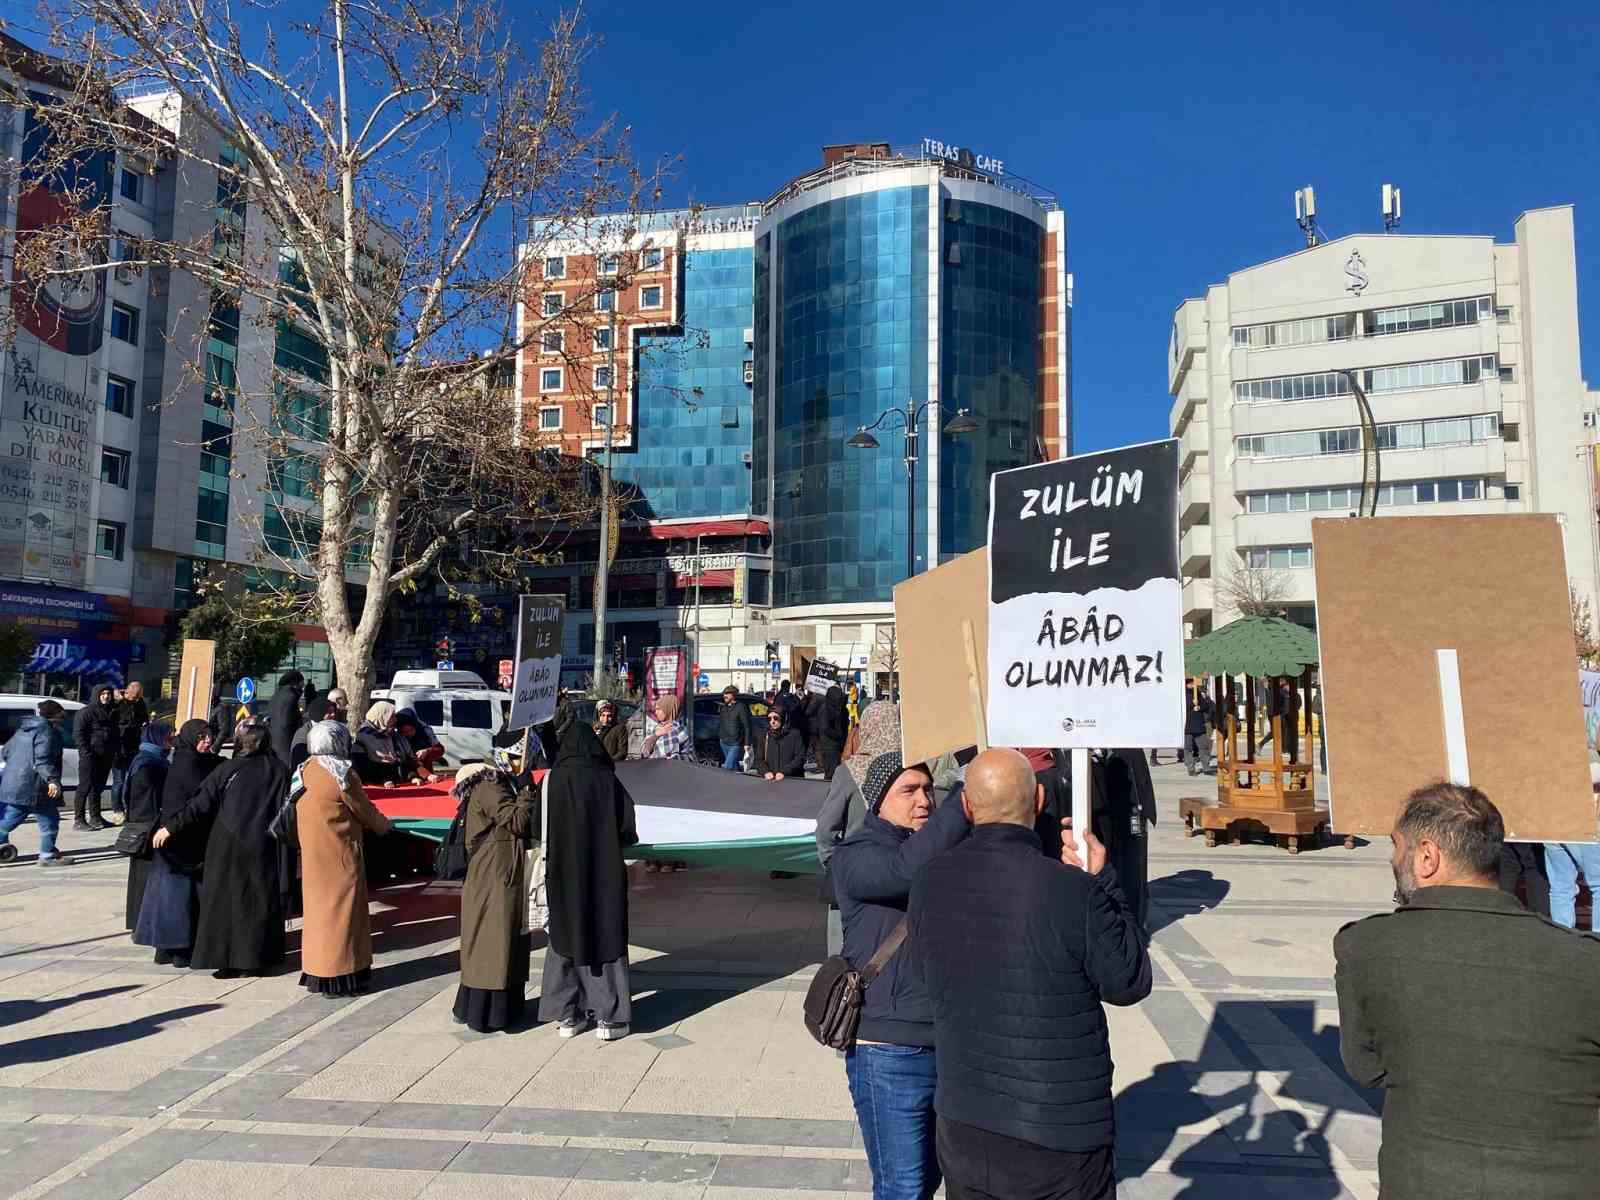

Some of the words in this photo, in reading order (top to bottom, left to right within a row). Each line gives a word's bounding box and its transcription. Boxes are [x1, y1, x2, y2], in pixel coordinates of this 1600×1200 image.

[924, 137, 959, 161] TERAS
[976, 154, 1004, 175] CAFE
[10, 442, 40, 461] DİL
[48, 449, 90, 474] KURSU
[1020, 464, 1143, 520] ZULÜM
[1050, 527, 1111, 572] İLE
[535, 628, 552, 648] İLE
[1036, 605, 1124, 649] ÂBÂD
[1005, 650, 1164, 688] OLUNMAZ!
